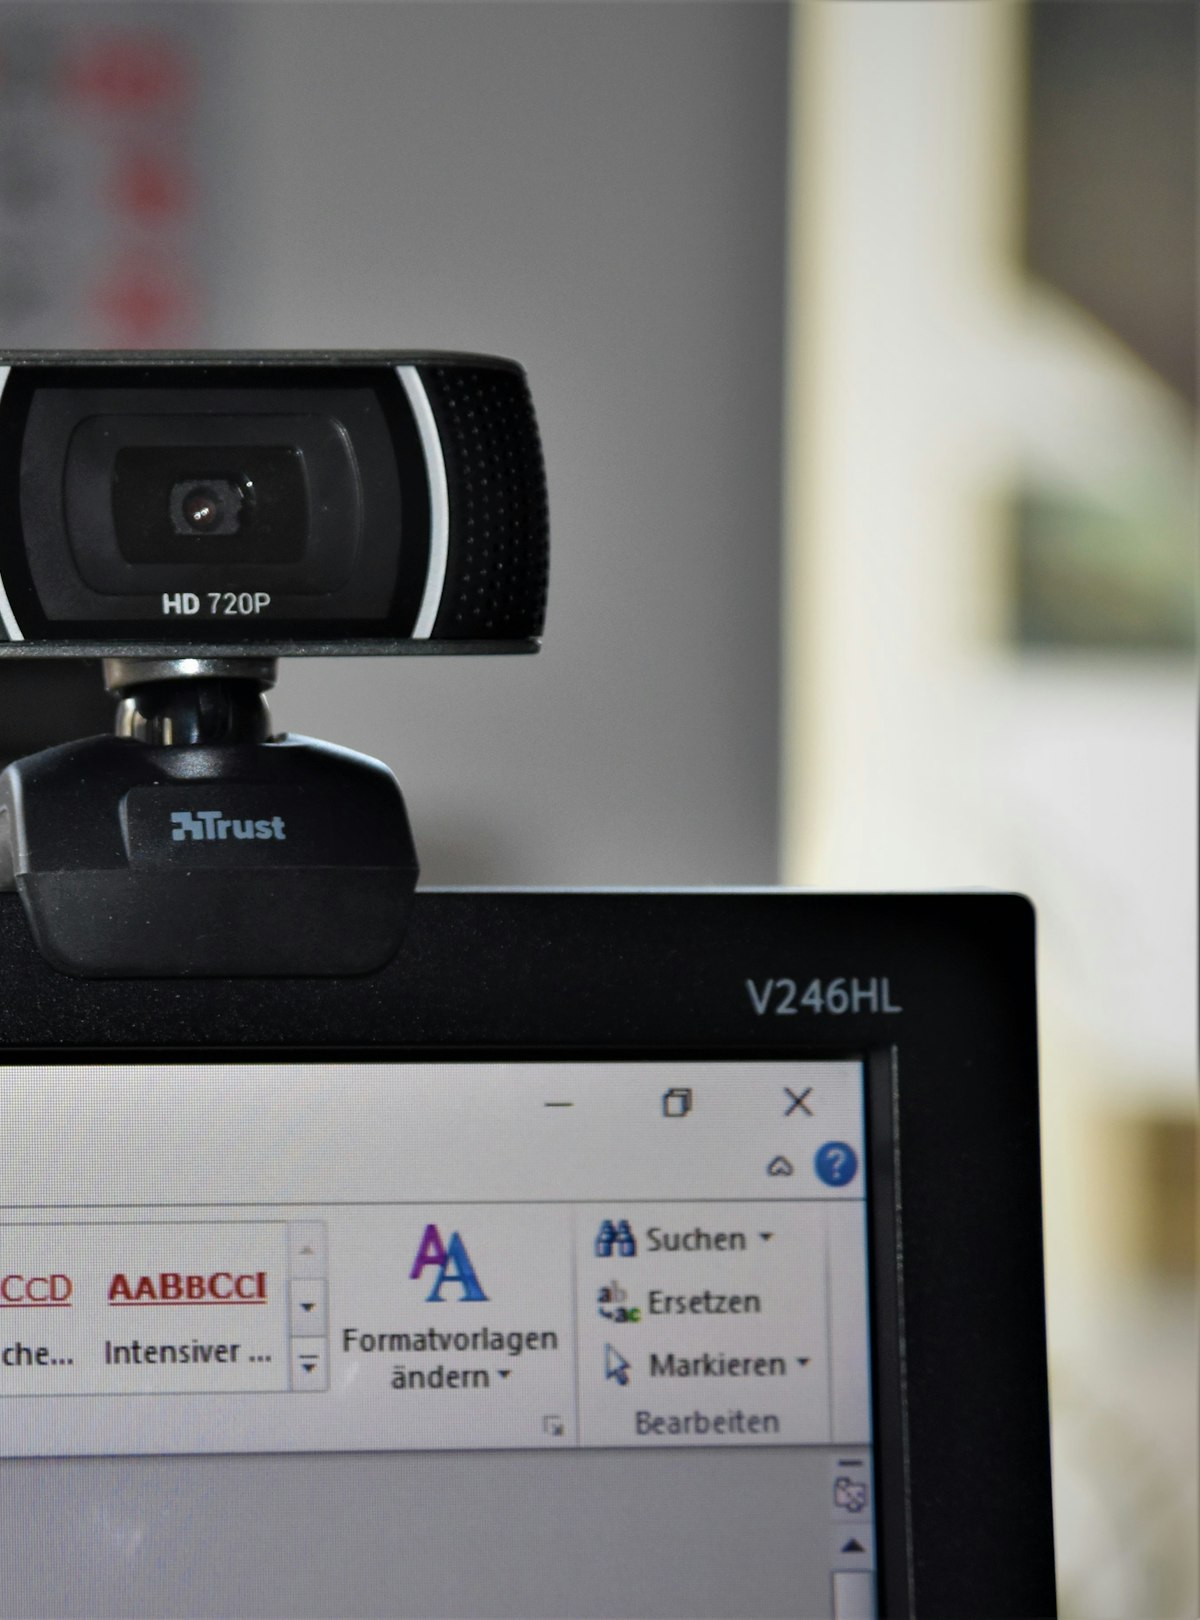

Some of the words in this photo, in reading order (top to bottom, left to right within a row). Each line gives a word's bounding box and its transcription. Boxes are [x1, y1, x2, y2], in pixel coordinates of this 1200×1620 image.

[162, 592, 200, 615] HD
[207, 592, 271, 615] 720P
[197, 811, 286, 841] Trust
[745, 977, 903, 1016] V246HL
[646, 1227, 747, 1252] Suchen
[648, 1289, 761, 1314] Ersetzen
[105, 1339, 240, 1365] Intensiver
[342, 1326, 559, 1356] Formatvorlagen
[391, 1365, 491, 1389] ändern
[649, 1351, 787, 1377] Markieren
[635, 1409, 781, 1436] Bearbeiten
